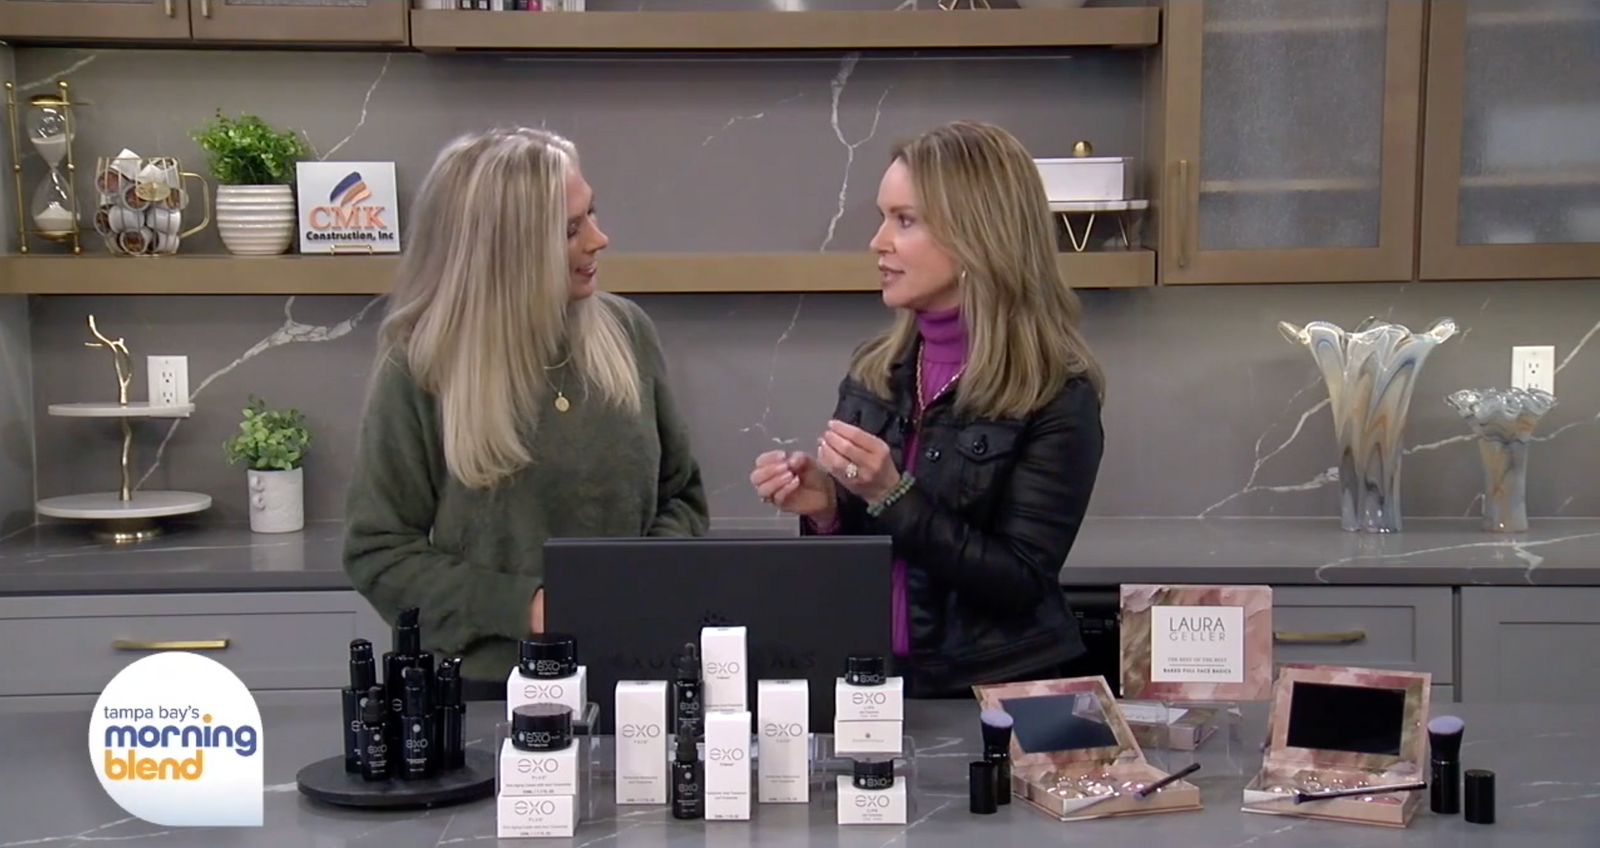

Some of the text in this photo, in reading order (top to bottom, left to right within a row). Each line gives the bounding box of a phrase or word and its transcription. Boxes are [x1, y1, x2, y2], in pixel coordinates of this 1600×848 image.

[308, 205, 387, 230] CMK
[306, 230, 394, 241] Construction, Inc
[1169, 616, 1225, 631] LAURA
[1169, 631, 1226, 642] GELLER
